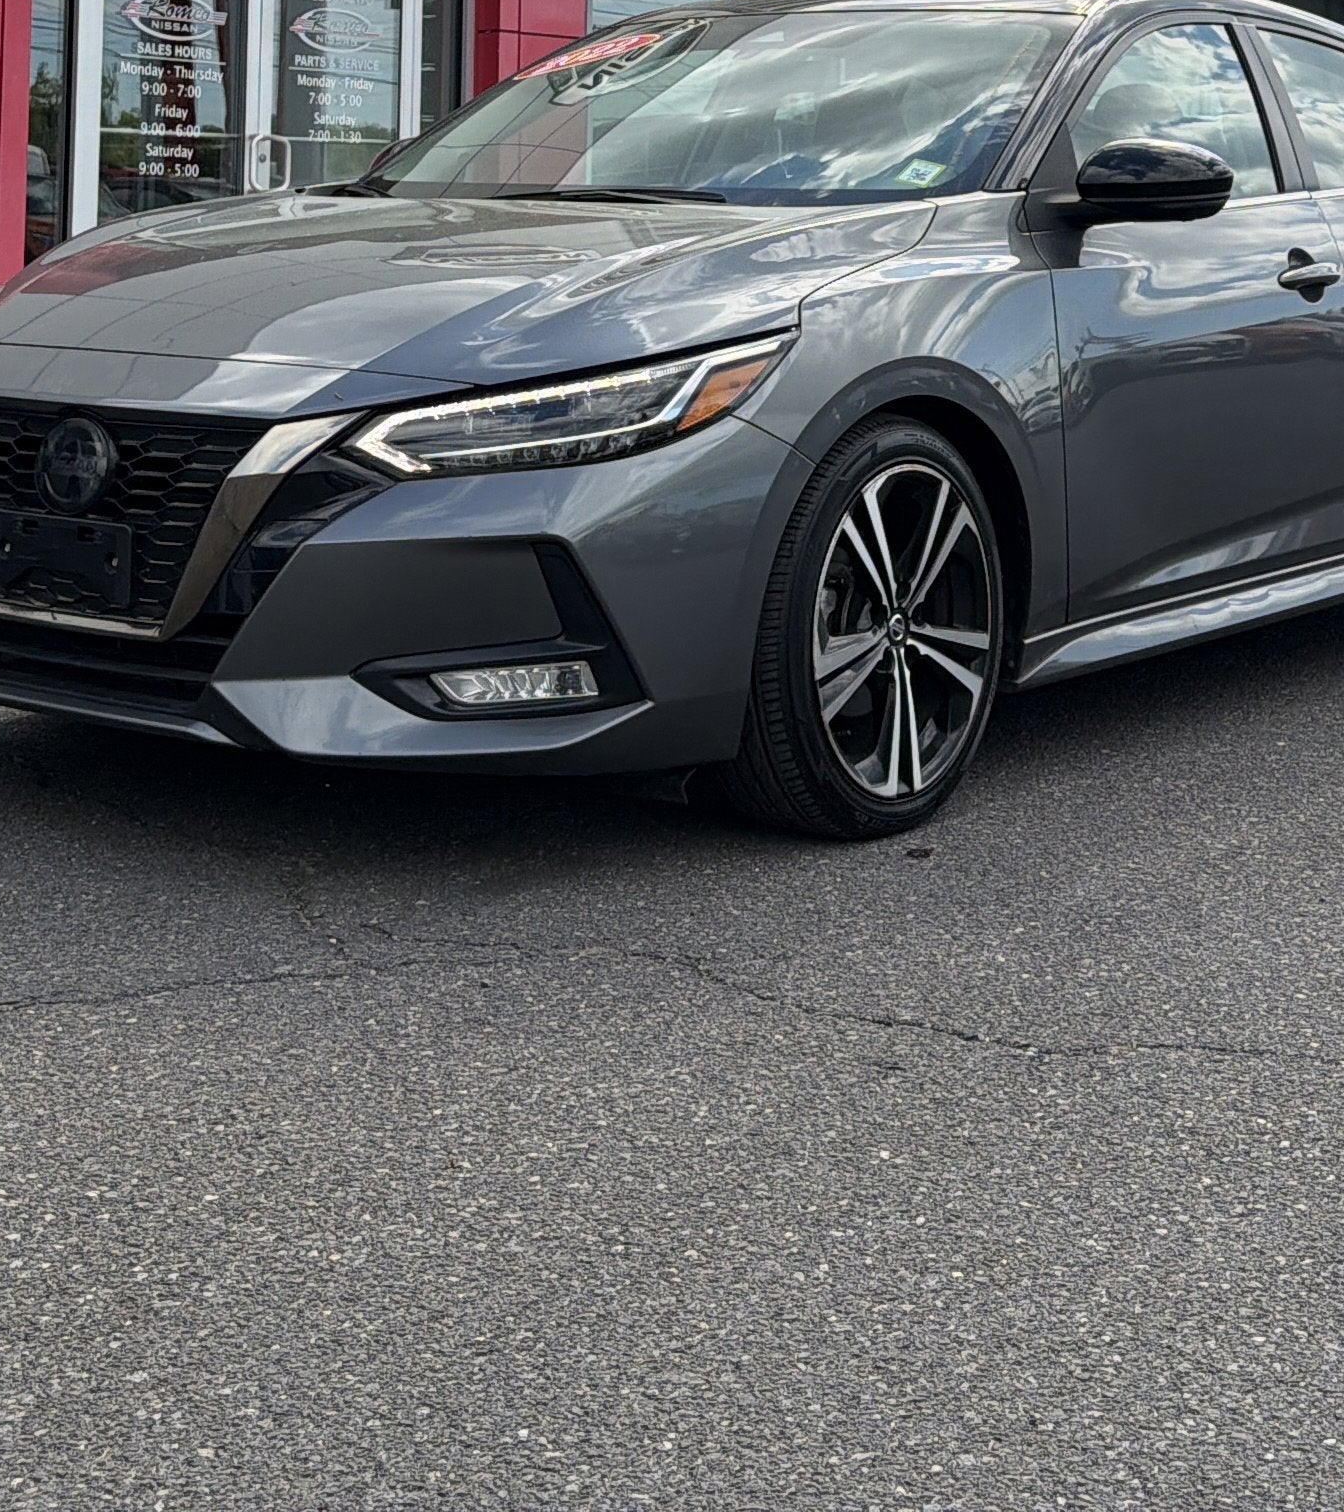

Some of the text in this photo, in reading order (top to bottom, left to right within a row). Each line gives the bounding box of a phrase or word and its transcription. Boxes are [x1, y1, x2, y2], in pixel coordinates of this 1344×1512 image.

[151, 19, 198, 33] NISSAN
[137, 41, 213, 59] SALES HOURS
[294, 54, 380, 71] PARTS & SERVICE
[120, 61, 164, 79] Monday
[174, 65, 224, 84] Thursday
[142, 81, 167, 96] 9:00
[177, 84, 202, 99] 7:00
[297, 74, 336, 90] Monday
[345, 77, 374, 92] Friday
[309, 92, 331, 105] 7:00
[340, 94, 362, 107] 5:00
[155, 103, 188, 121] Friday
[313, 112, 357, 127] Saturday
[140, 122, 166, 136] 9:00
[176, 123, 201, 138] 6:00
[308, 129, 331, 143] 7:00
[145, 143, 194, 161] Saturday
[139, 162, 164, 176] 9:00
[175, 163, 200, 177] 5:00
